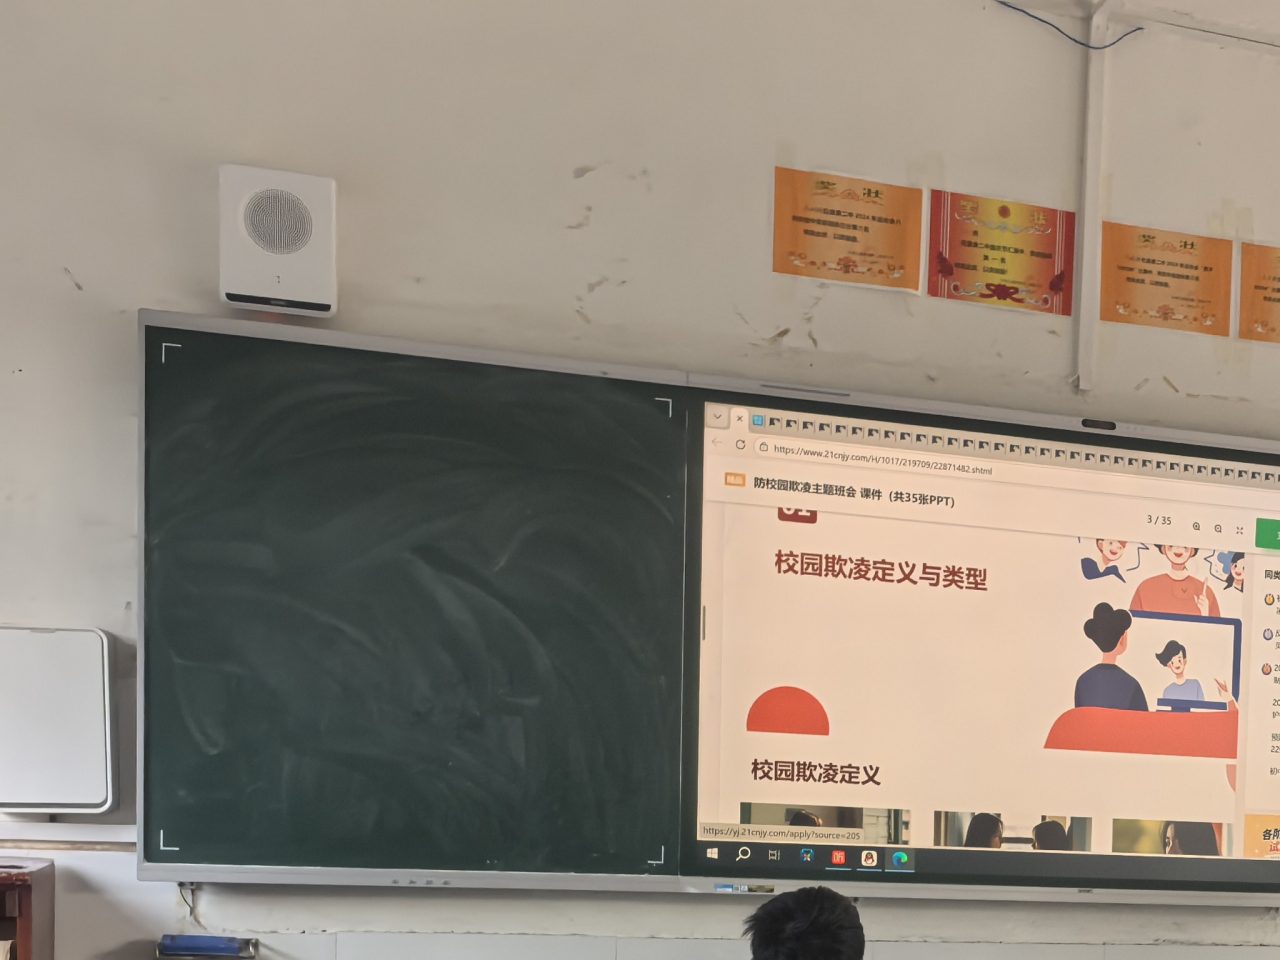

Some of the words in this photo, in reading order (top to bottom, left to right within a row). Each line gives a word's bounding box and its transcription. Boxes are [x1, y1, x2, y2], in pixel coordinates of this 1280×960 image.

[754, 476, 857, 498] 防校园欺凌主题班会
[1161, 516, 1172, 526] 35
[775, 549, 988, 592] 校园欺凌定义与类型
[751, 758, 881, 786] 校园欺凌定义
